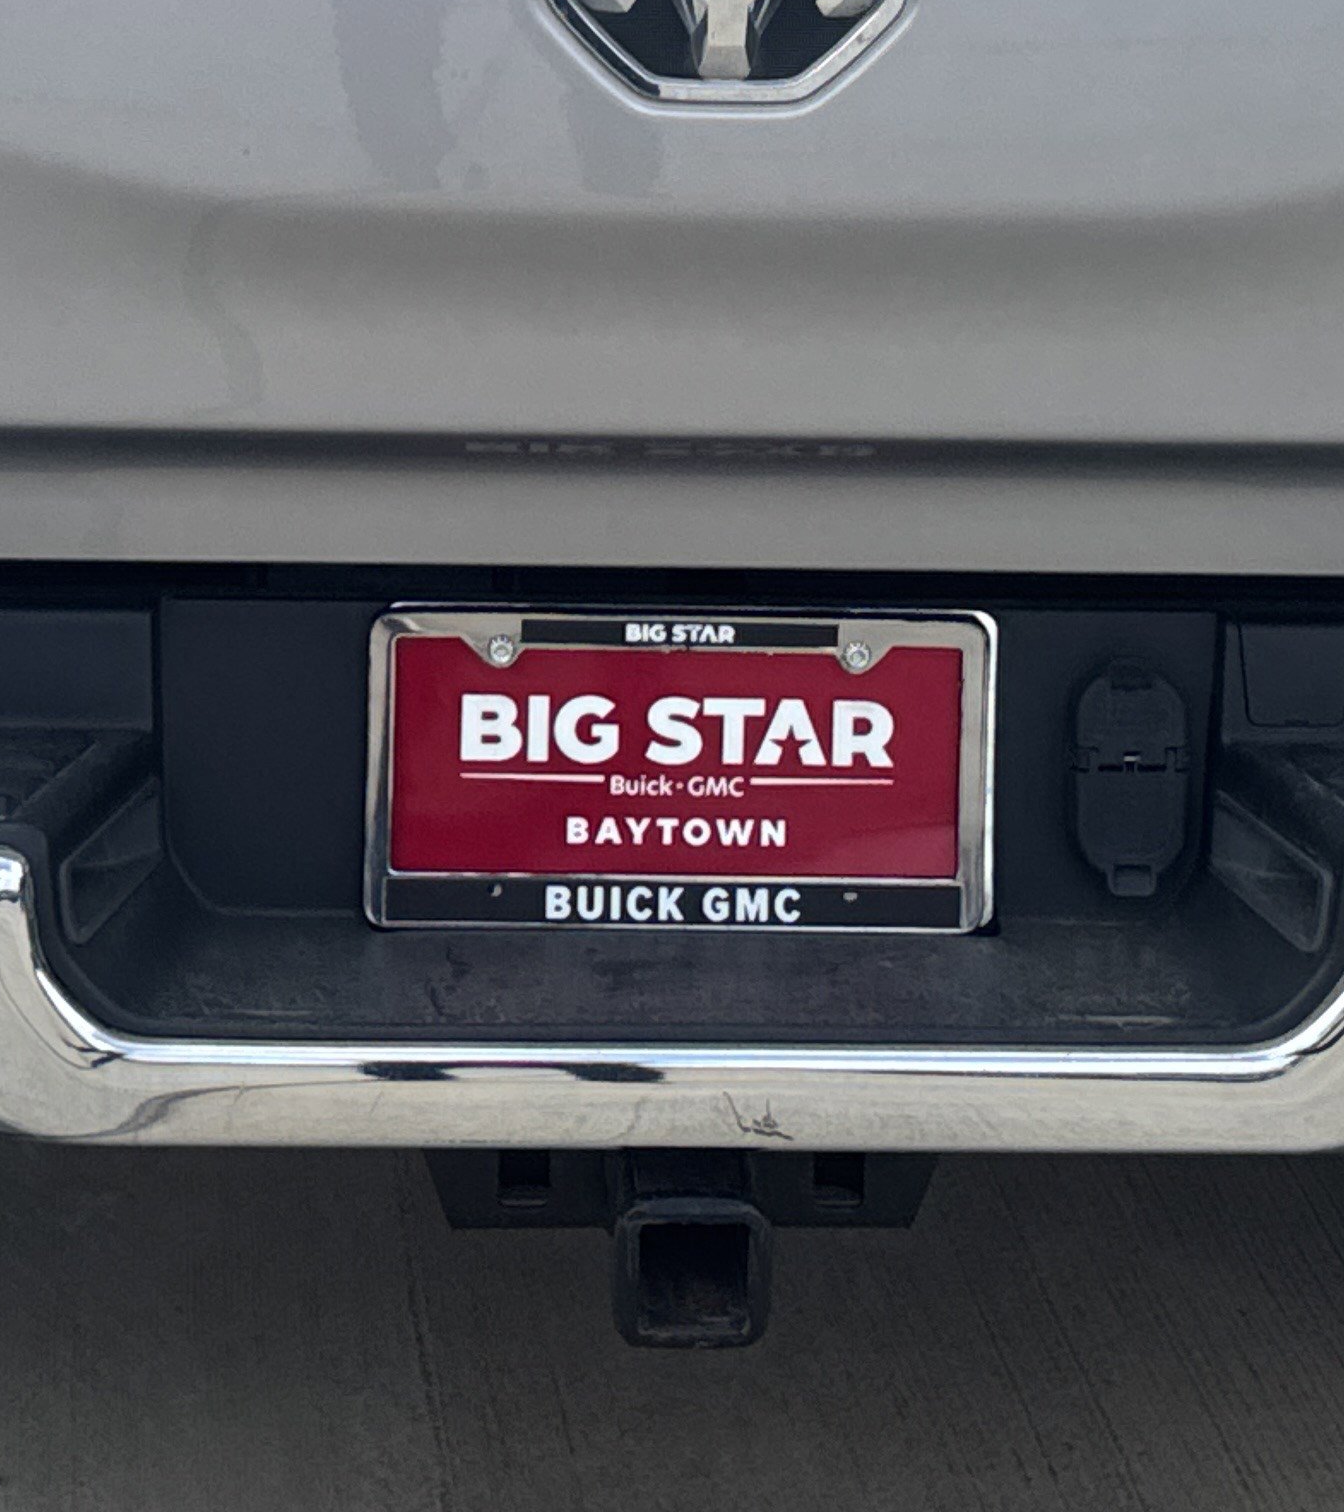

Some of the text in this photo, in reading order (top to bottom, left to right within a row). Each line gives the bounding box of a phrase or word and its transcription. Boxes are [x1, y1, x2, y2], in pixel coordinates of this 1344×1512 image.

[625, 623, 736, 644] BIG STAR
[460, 693, 894, 768] BIG STAR
[609, 774, 745, 798] Buick GMC
[566, 816, 787, 847] BAYTOWN
[544, 885, 802, 924] BUICK GMC
